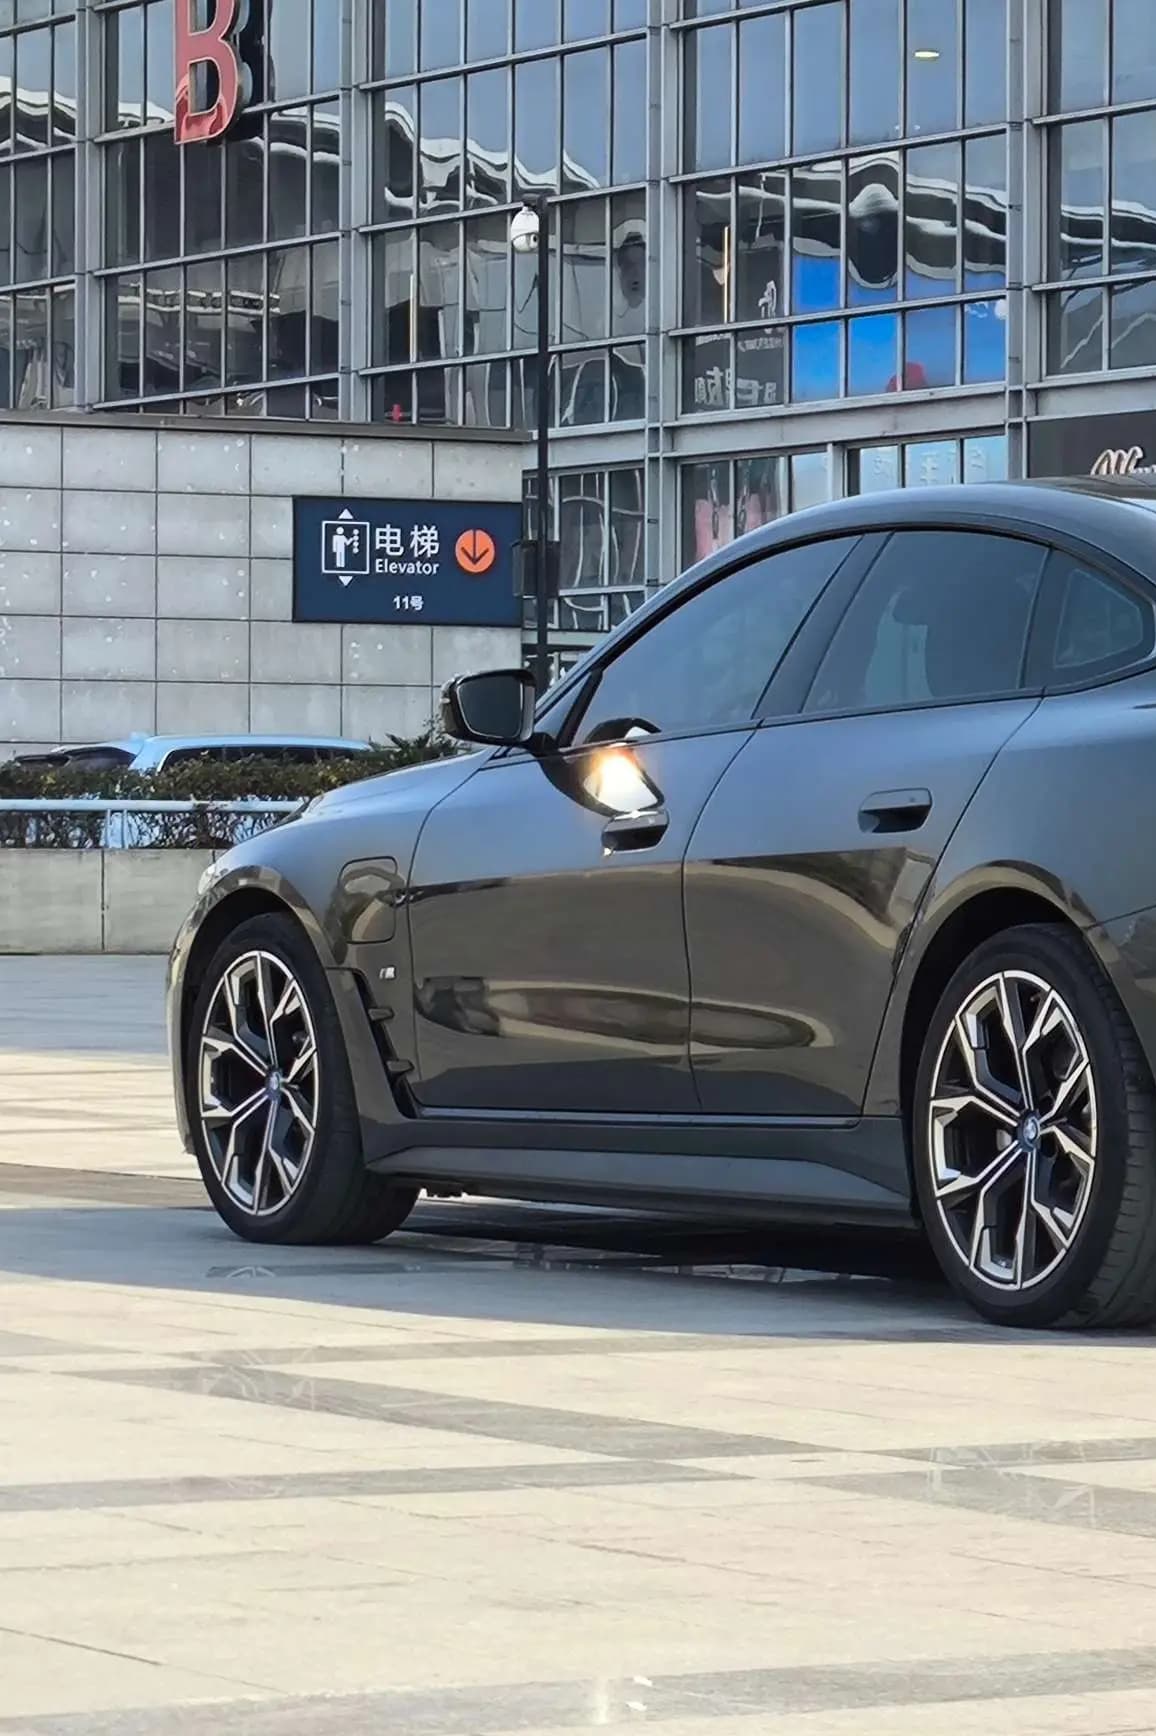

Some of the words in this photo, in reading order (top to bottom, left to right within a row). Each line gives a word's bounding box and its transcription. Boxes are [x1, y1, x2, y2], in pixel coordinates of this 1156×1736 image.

[174, 0, 239, 144] B
[375, 524, 440, 557] 电梯
[375, 558, 440, 575] Elevator
[393, 595, 424, 611] 11号
